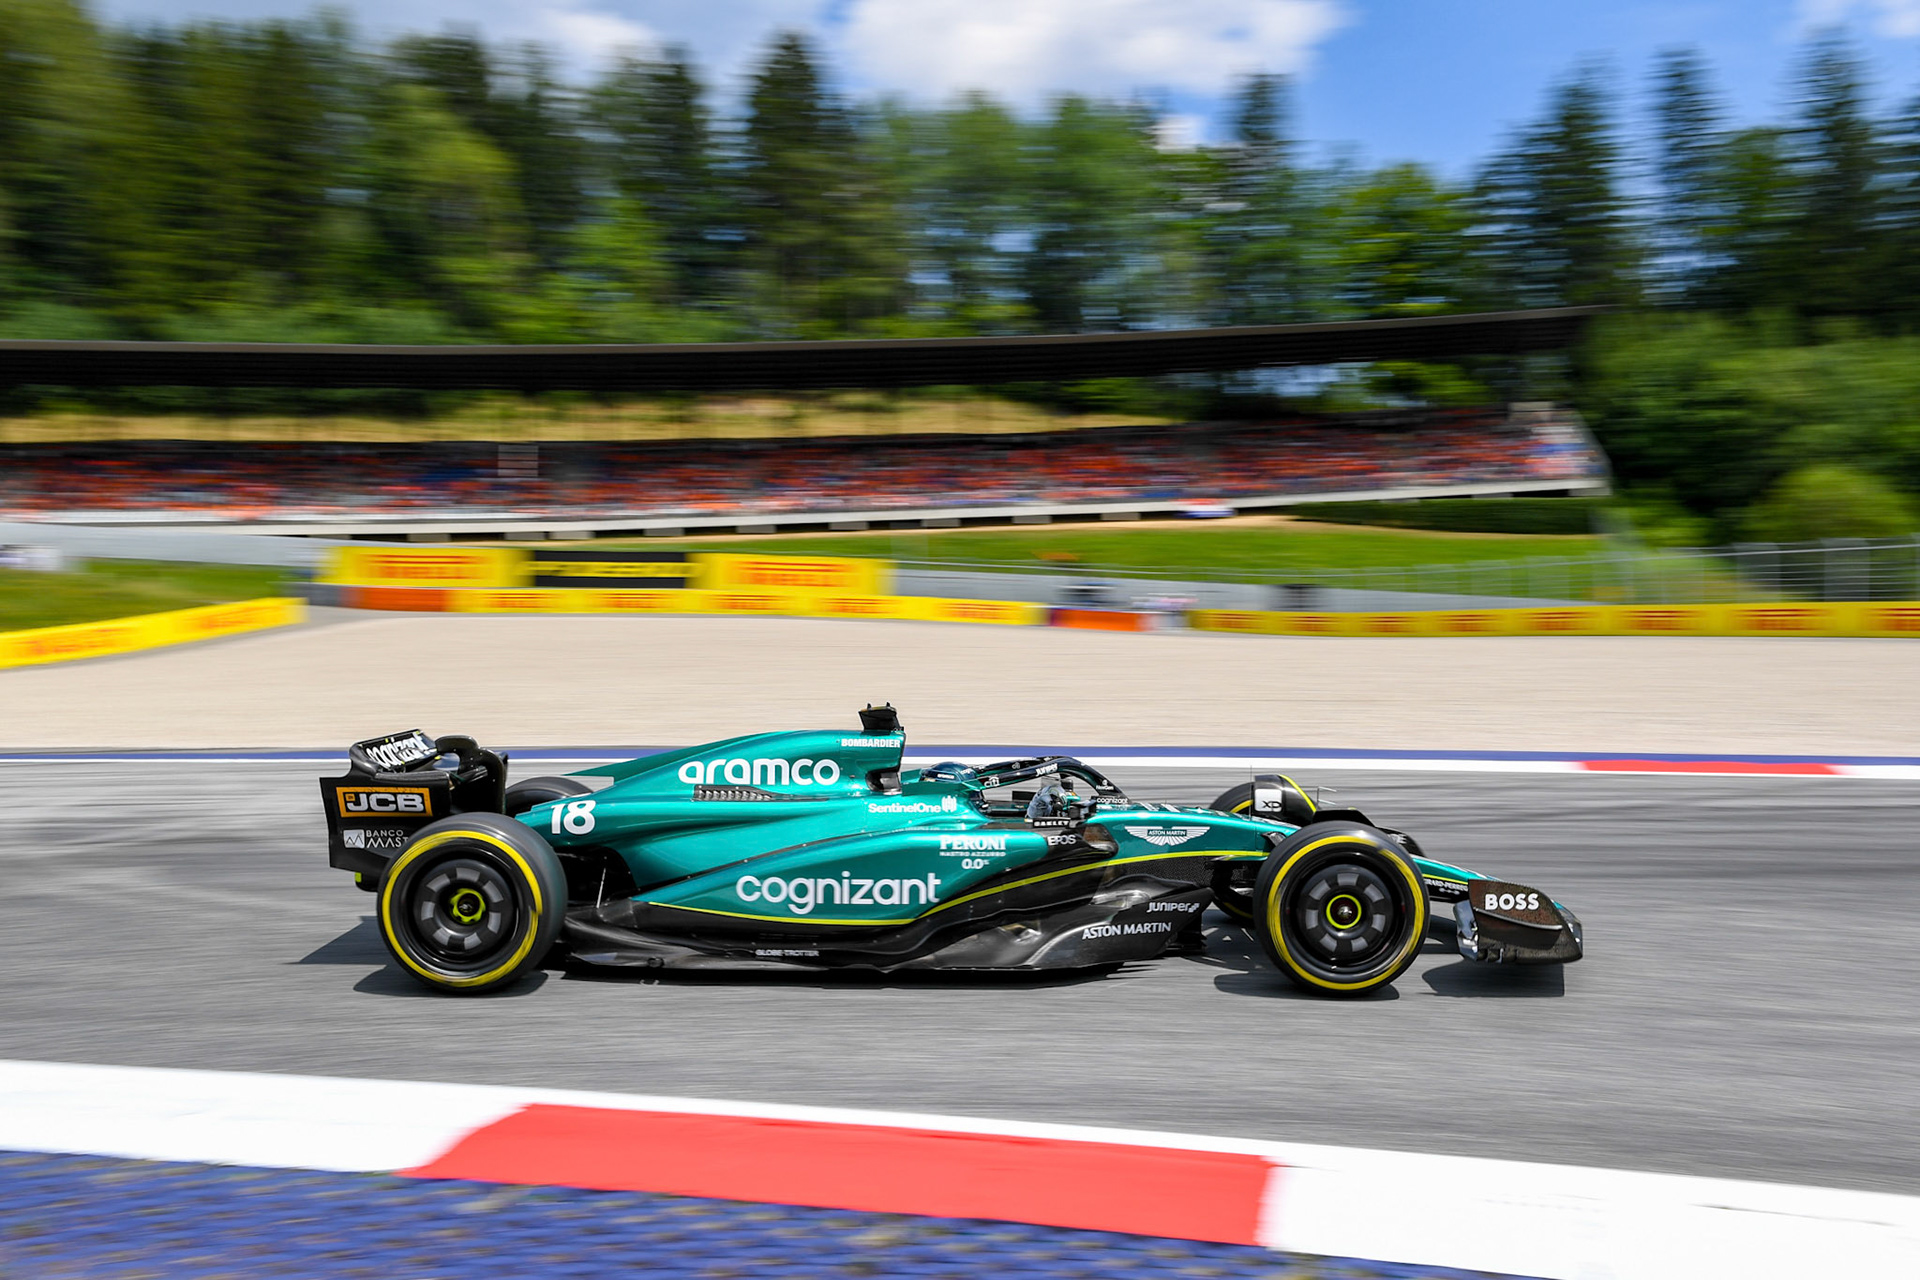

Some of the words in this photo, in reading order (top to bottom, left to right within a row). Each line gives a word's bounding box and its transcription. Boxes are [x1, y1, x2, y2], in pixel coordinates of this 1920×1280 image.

[841, 738, 901, 748] BOMBARDIER
[678, 758, 840, 786] aramco
[984, 776, 1000, 788] citi
[347, 793, 425, 812] JCB
[868, 803, 941, 813] SentinelOne
[551, 799, 597, 835] 18
[366, 830, 404, 838] BANCO
[1047, 835, 1077, 846] EPOS
[940, 835, 1006, 850] PERONI
[735, 870, 941, 915] cognizant
[1484, 893, 1540, 911] BOSS
[1081, 924, 1122, 940] ASTON
[1123, 922, 1172, 935] MARTIN
